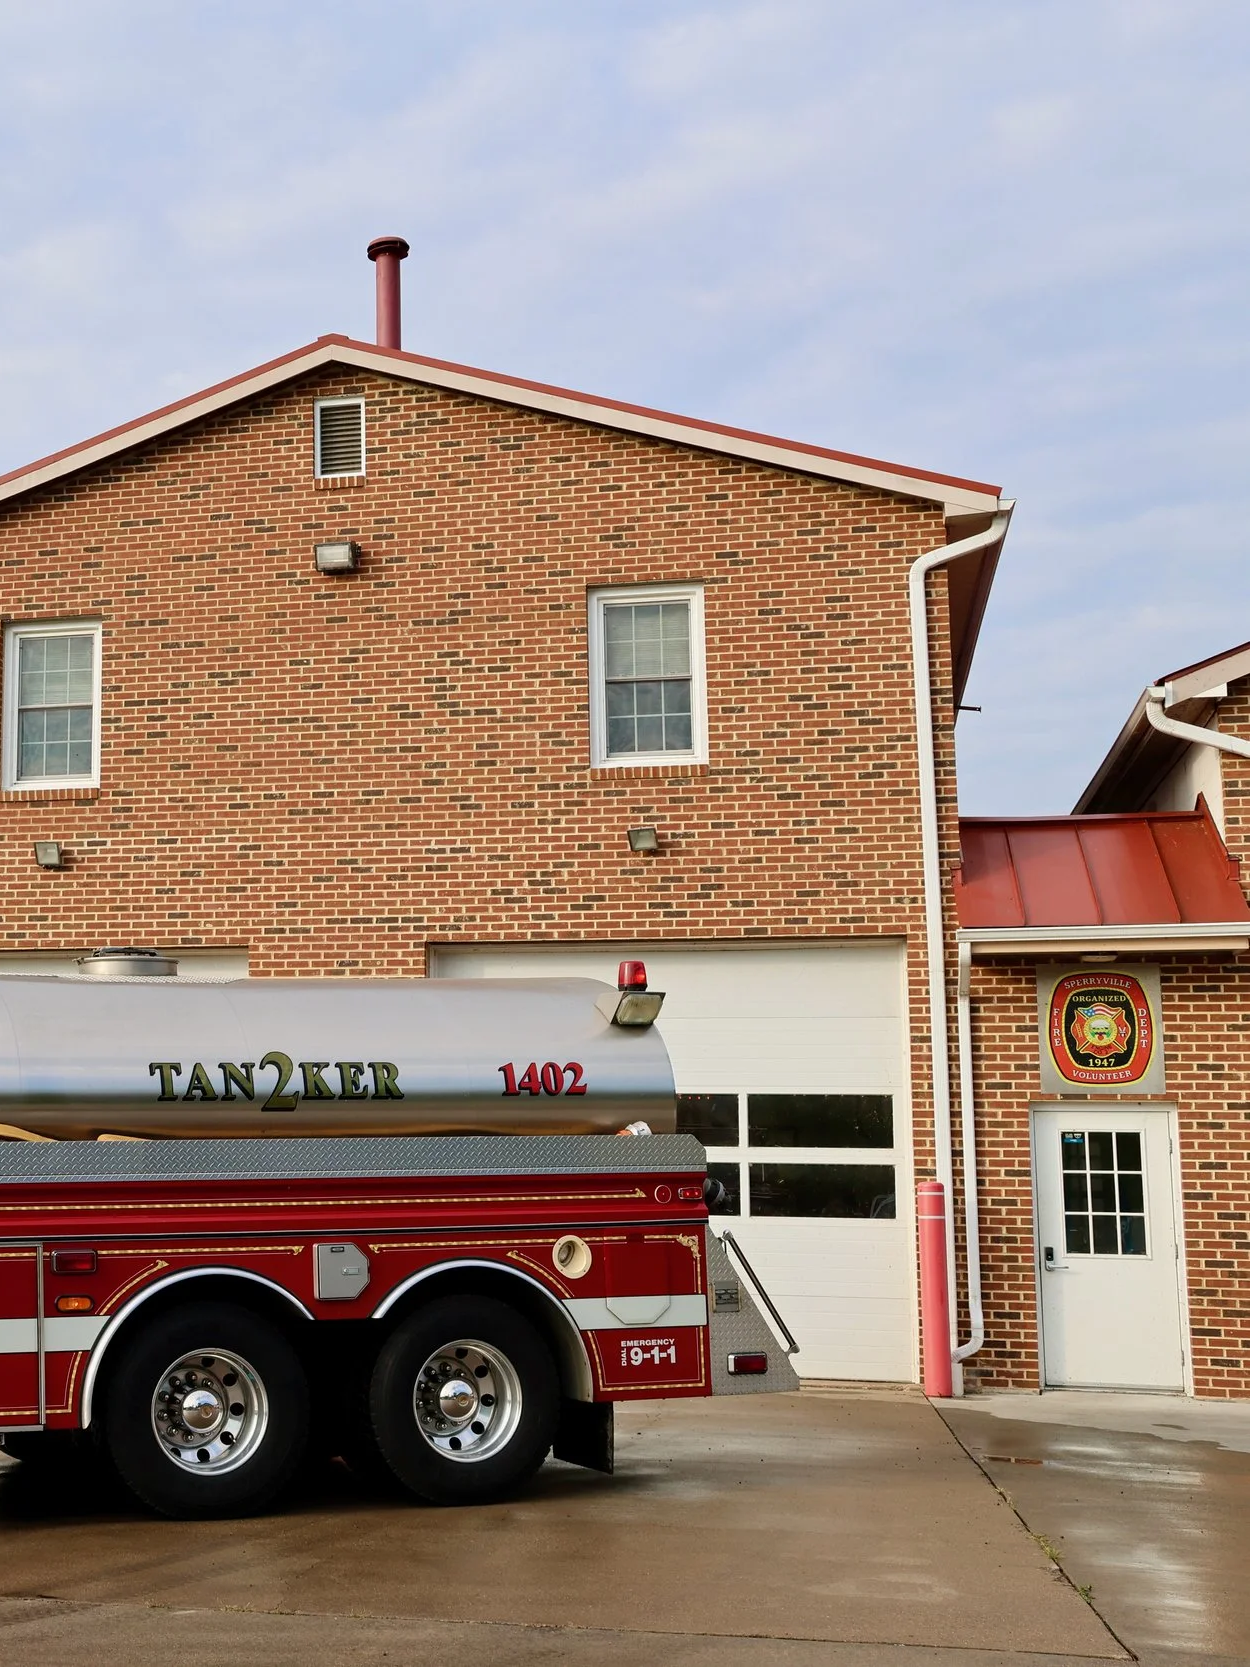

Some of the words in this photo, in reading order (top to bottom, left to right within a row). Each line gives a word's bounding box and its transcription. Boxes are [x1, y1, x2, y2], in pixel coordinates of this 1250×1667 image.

[1064, 977, 1132, 990] SPERRYVILLE
[1053, 1008, 1062, 1047] FIRE
[1138, 1008, 1148, 1048] DEPT
[1088, 1058, 1115, 1067] 1947
[498, 1062, 588, 1097] 1402
[1072, 1070, 1132, 1081] VOLUNTEER
[621, 1338, 675, 1347] EMERGENCY
[630, 1345, 676, 1366] 9-1-1
